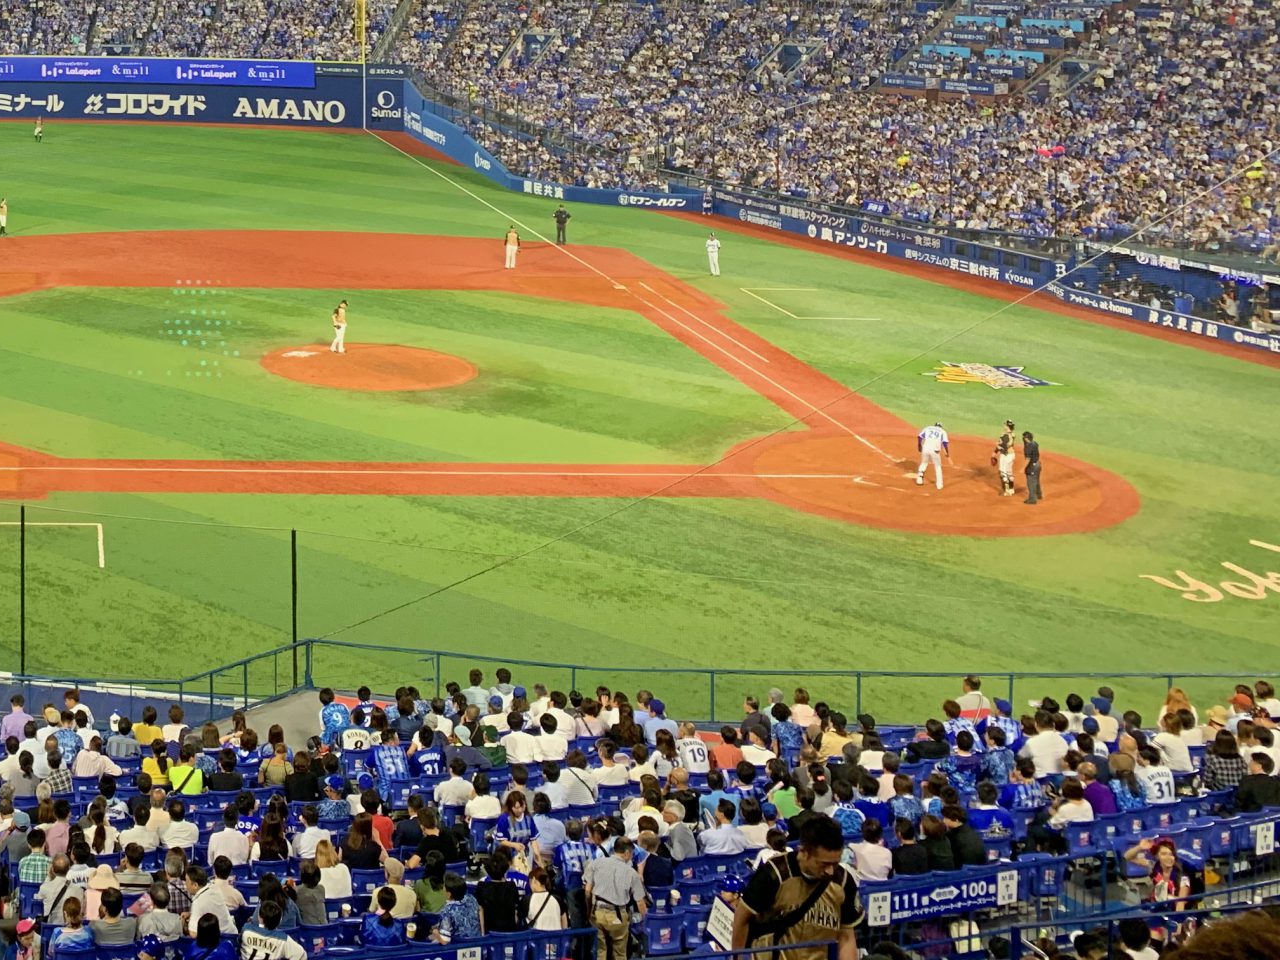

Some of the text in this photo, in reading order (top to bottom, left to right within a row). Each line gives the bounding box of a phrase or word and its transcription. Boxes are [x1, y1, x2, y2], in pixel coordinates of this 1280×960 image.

[66, 67, 101, 77] LaLaport
[201, 69, 237, 79] LaLaport
[106, 93, 207, 116] コロワイド
[233, 97, 346, 123] AMANO
[371, 107, 401, 119] Sumai
[1005, 269, 1033, 286] KYOSAN
[689, 747, 706, 763] 19
[1153, 781, 1171, 800] 31
[246, 936, 276, 953] OHTANI
